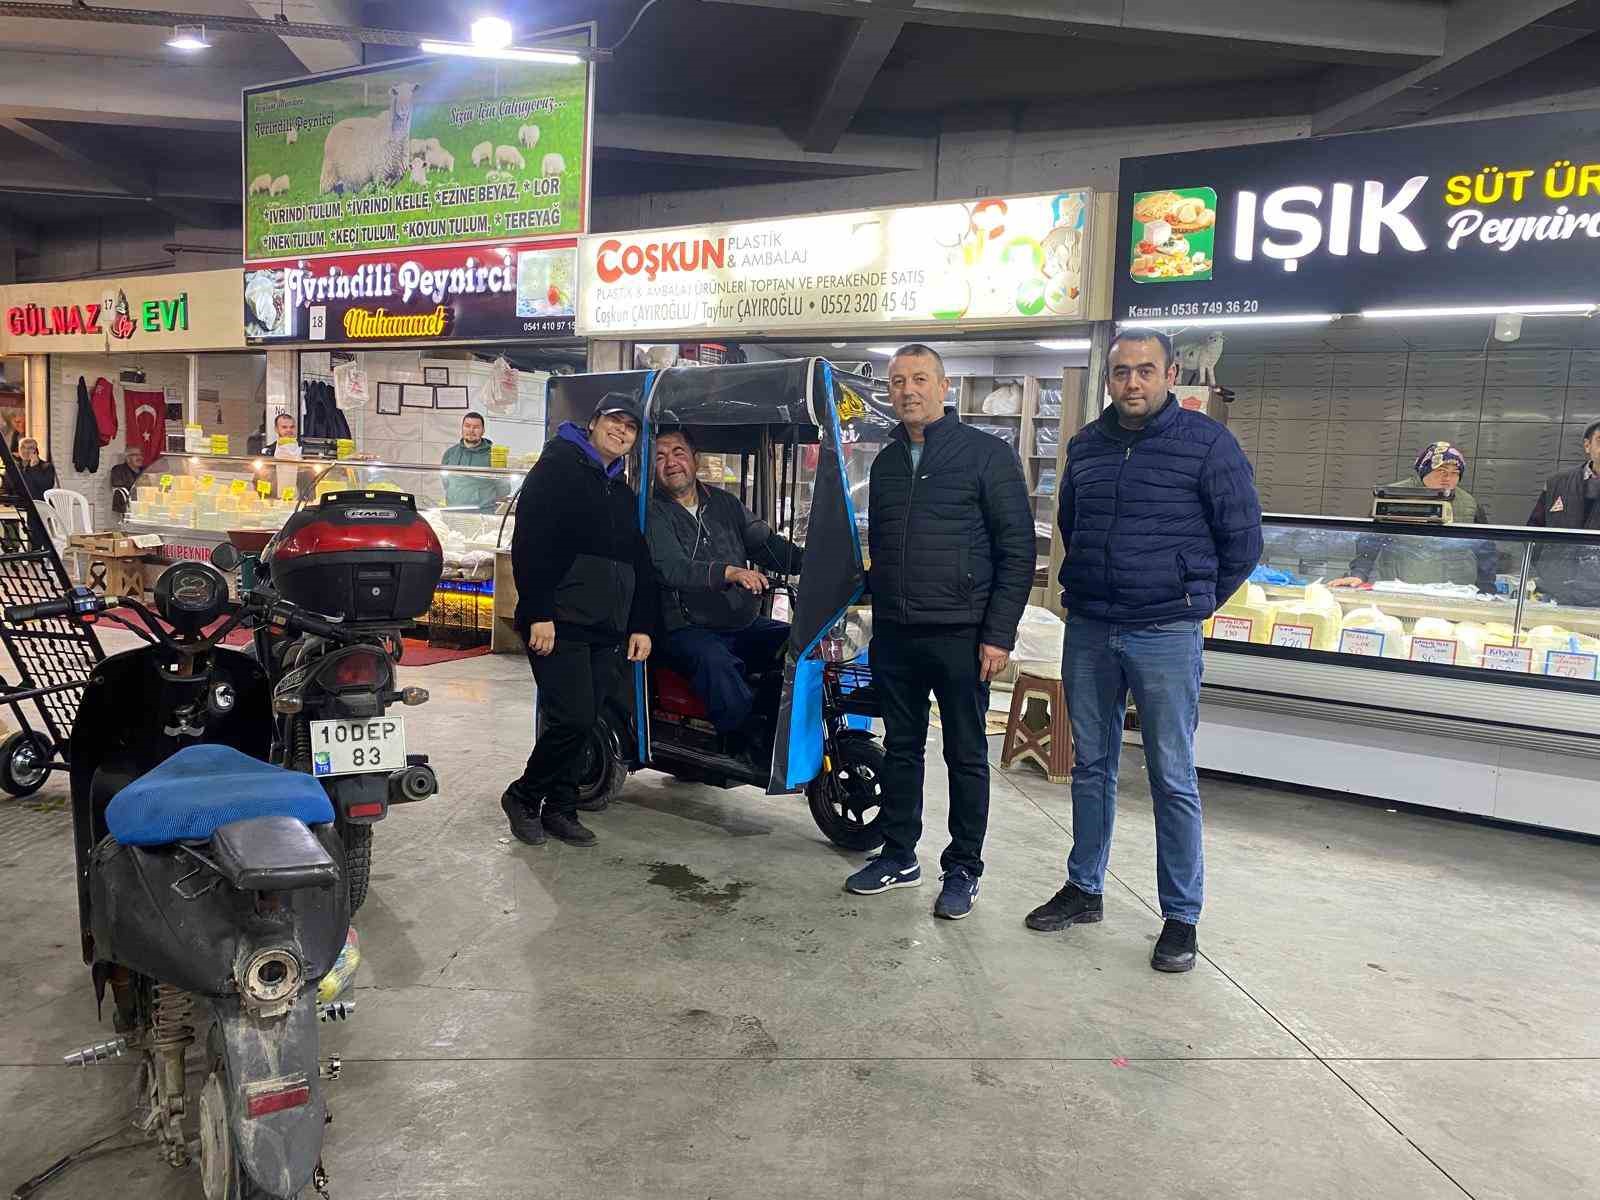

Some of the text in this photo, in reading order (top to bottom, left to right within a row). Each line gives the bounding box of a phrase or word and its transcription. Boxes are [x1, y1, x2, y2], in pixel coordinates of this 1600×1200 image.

[535, 177, 560, 196] LOR
[1444, 165, 1535, 206] SÜT
[1233, 175, 1430, 272] IŞIK
[728, 231, 783, 250] PLASTİK
[727, 248, 807, 268] & AMBALAJ
[399, 254, 514, 303] Peynirci
[695, 277, 748, 296] ÜRÜNLERİ
[752, 276, 796, 292] TOPTAN
[799, 276, 813, 289] VE
[817, 271, 888, 289] PERAKENDE
[8, 303, 102, 336] GÜLNAZ
[143, 292, 188, 332] EVİ
[104, 299, 113, 311] 17
[702, 300, 734, 323] Tayfur
[737, 293, 803, 323] ÇAYIROĞLU
[821, 294, 850, 315] 0552
[854, 293, 877, 313] 320
[881, 291, 897, 311] 45
[901, 290, 917, 311] 45
[1129, 305, 1162, 317] Kazım
[1172, 303, 1199, 316] 0536
[1202, 302, 1223, 314] 749
[1226, 301, 1240, 313] 36
[1243, 300, 1258, 312] 20
[312, 315, 323, 328] 18
[344, 306, 447, 338] Muhammet
[523, 321, 540, 332] 0541
[542, 321, 555, 331] 410
[556, 320, 566, 330] 97
[321, 722, 396, 744] 10DEP
[353, 746, 381, 767] 83
[318, 764, 329, 772] TR
